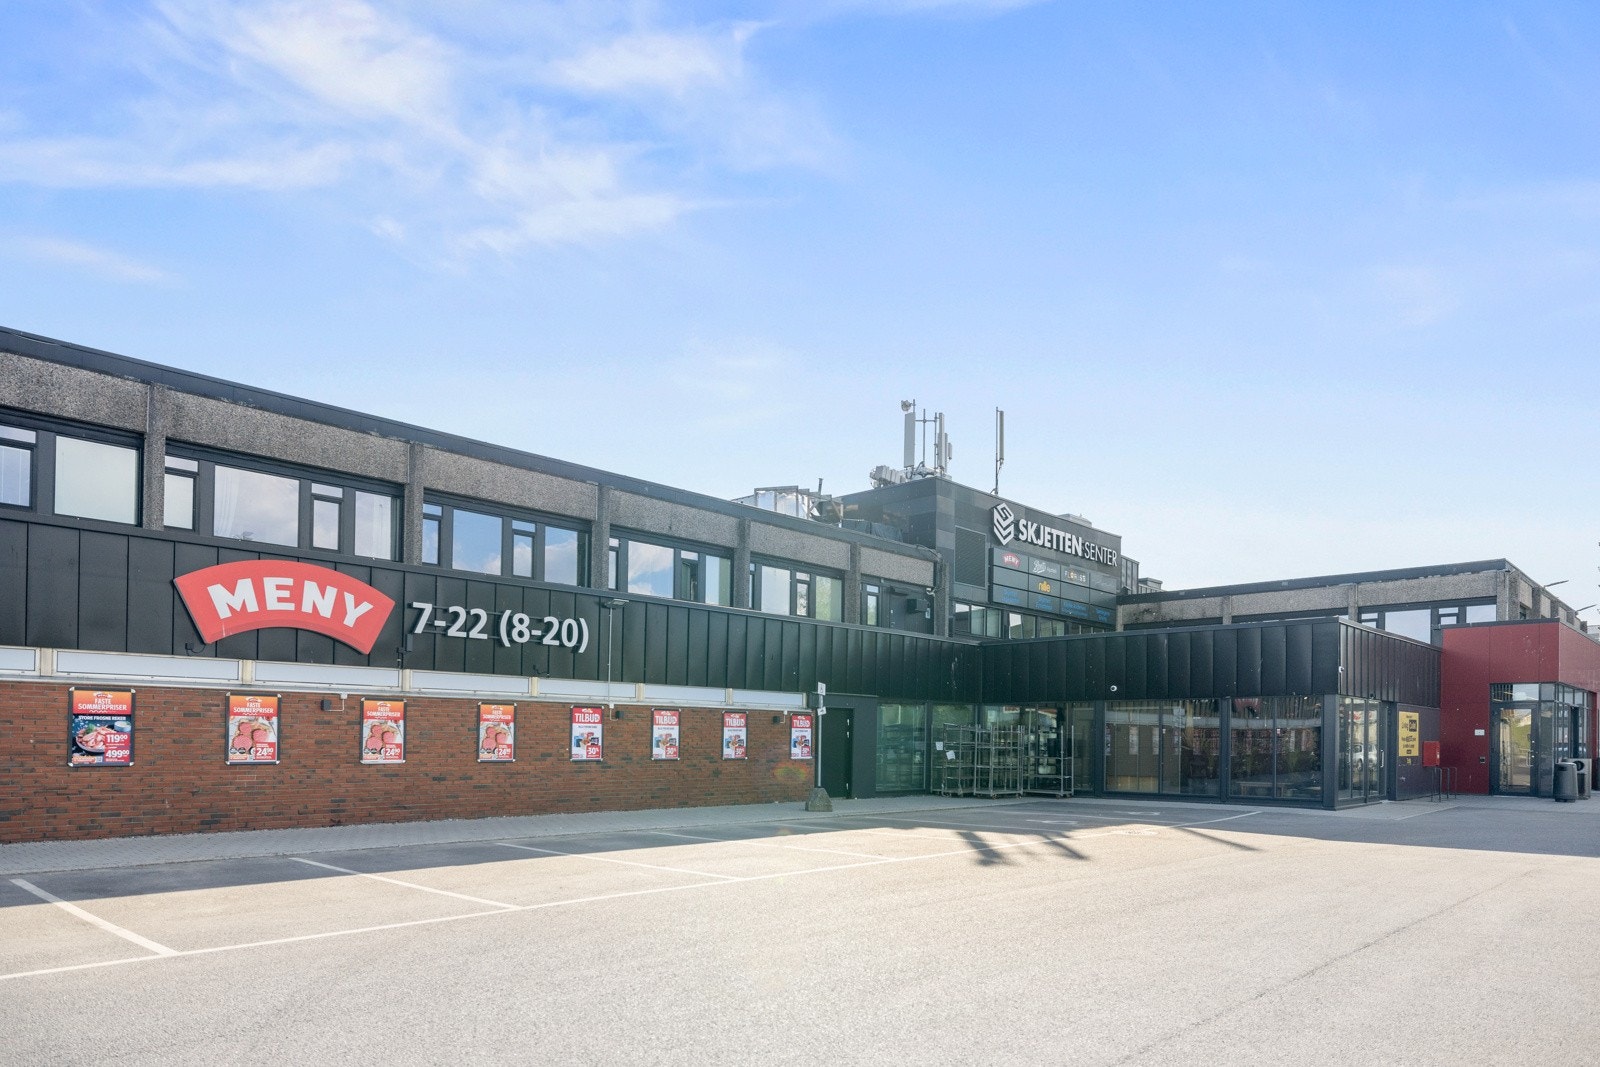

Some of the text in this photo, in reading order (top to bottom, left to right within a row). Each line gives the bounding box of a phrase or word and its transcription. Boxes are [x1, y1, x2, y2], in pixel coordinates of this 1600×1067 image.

[1018, 518, 1118, 567] SKJETTEN SENTER
[206, 577, 374, 628] MENY
[412, 601, 589, 654] 7-22 (8-20)
[574, 713, 600, 723] TILBUD
[655, 715, 678, 725] TILBUD
[725, 718, 745, 727] TILBUD
